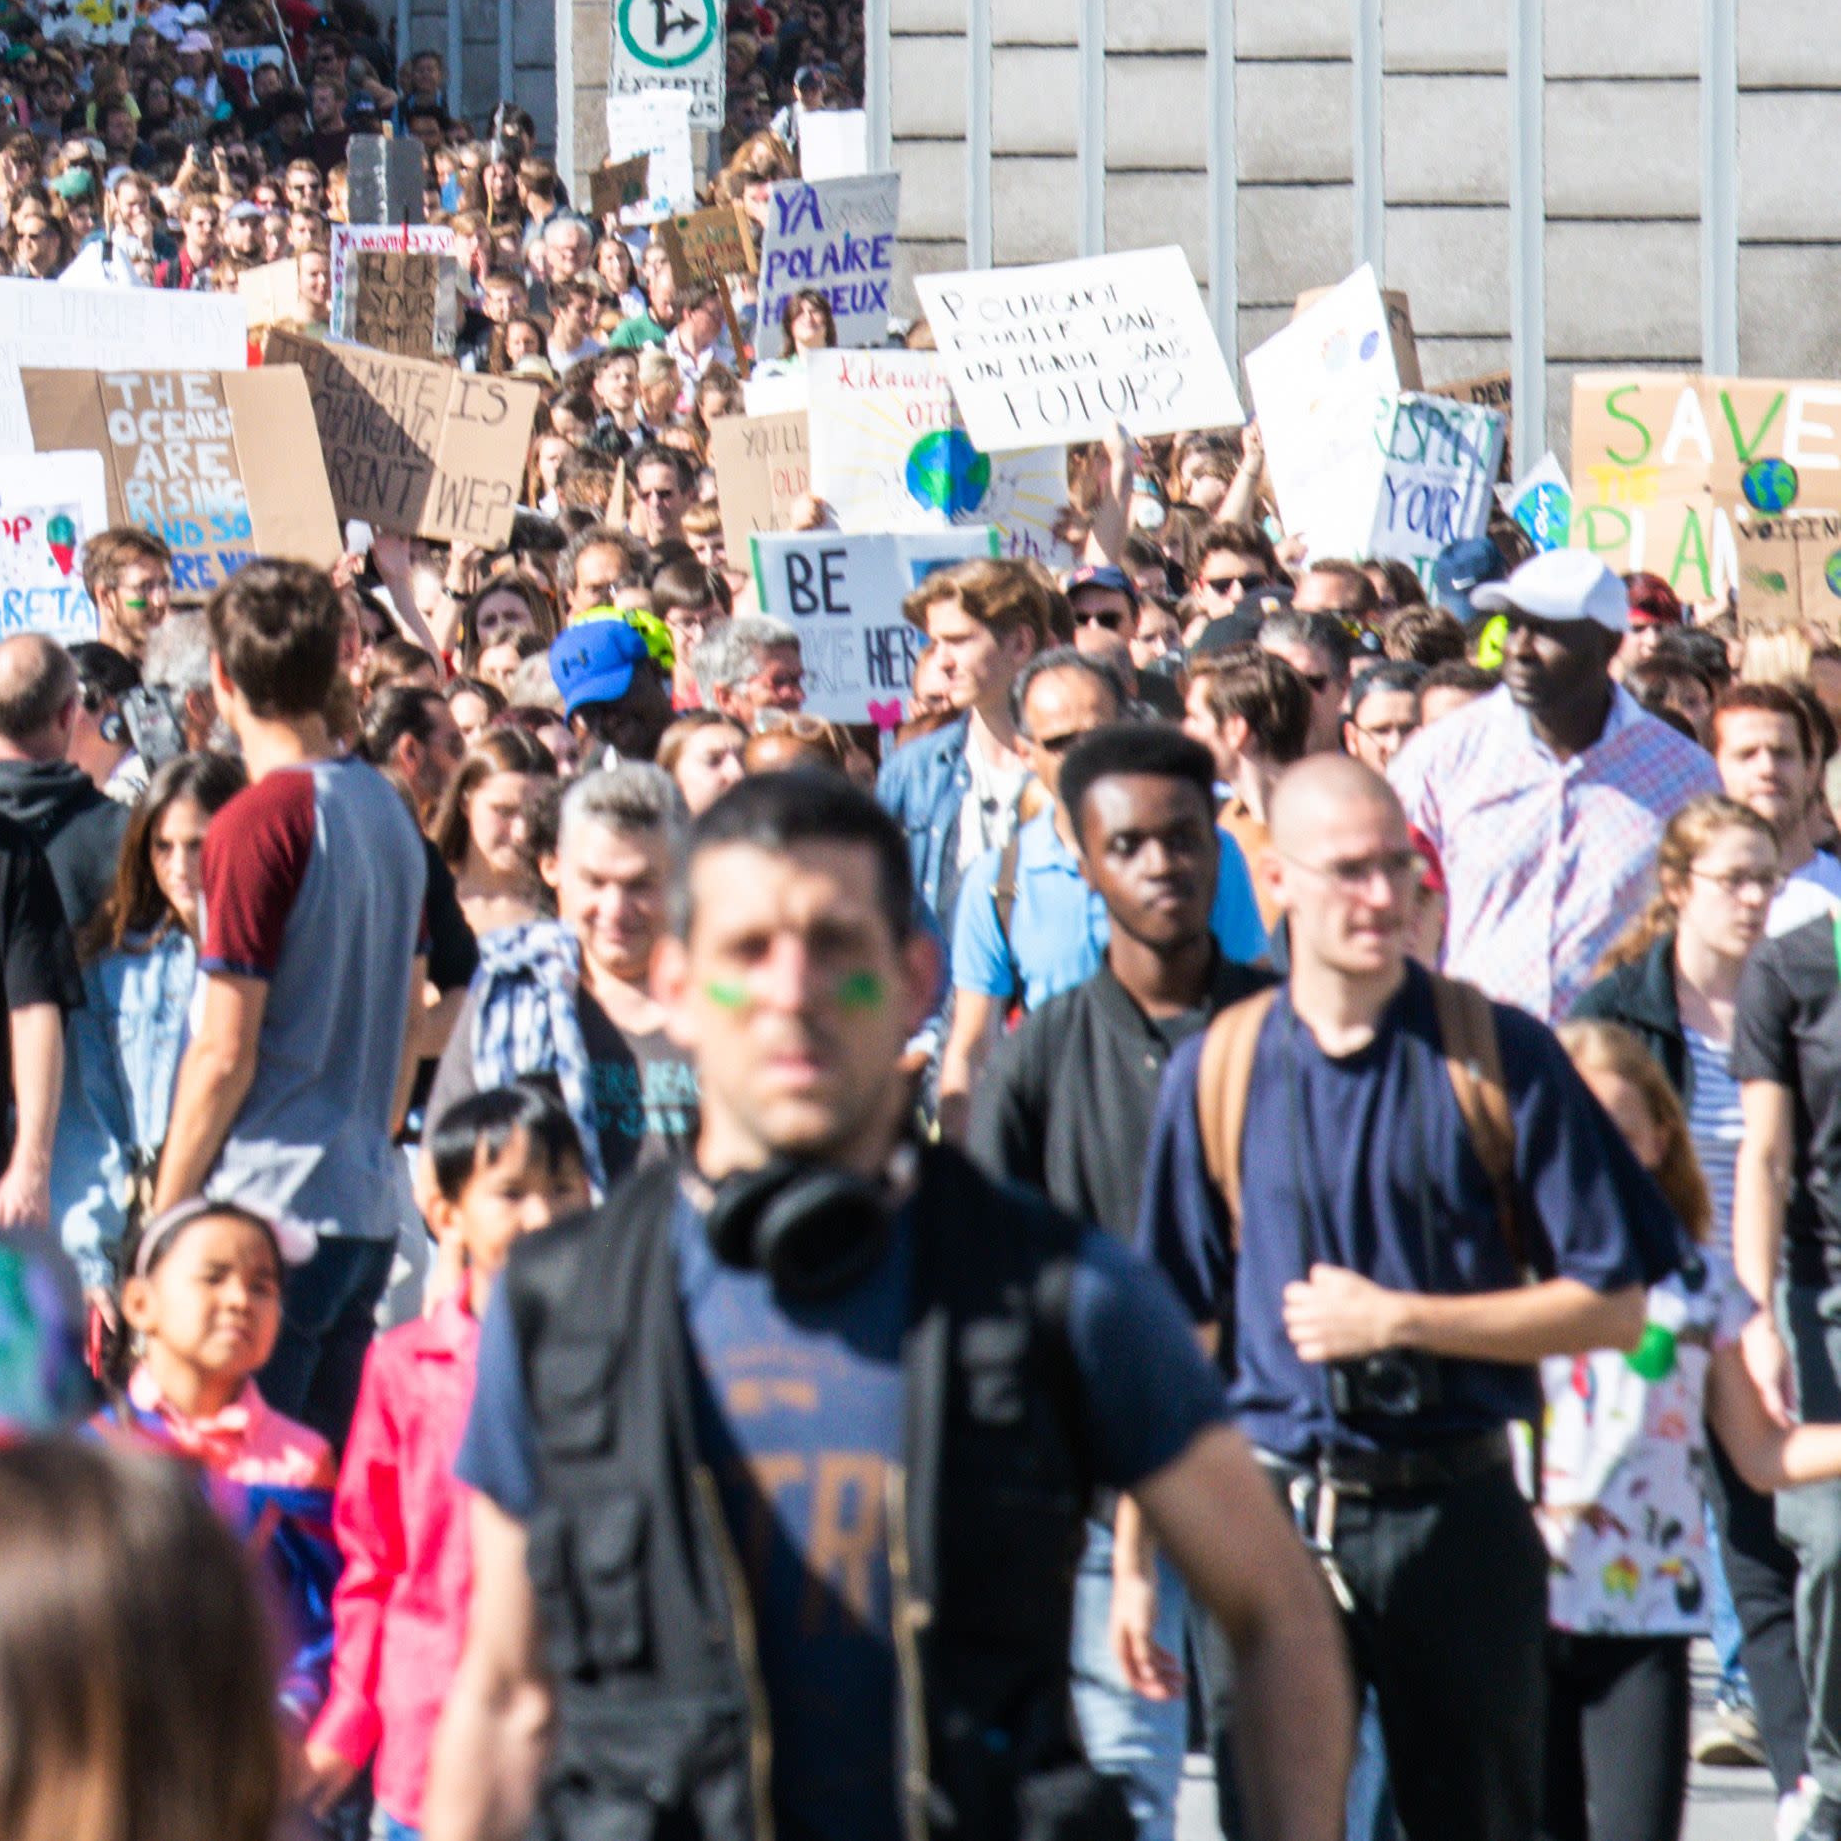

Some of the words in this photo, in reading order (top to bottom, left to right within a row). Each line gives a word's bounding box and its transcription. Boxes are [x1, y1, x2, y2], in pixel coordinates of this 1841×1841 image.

[765, 231, 893, 288] POLAIRE
[104, 372, 218, 412] THE
[447, 376, 510, 427] IS
[1002, 370, 1186, 430] FUTUR?
[107, 407, 232, 447] OCEANS
[1605, 381, 1841, 466] SAVE
[133, 443, 231, 481] ARE
[124, 479, 249, 527] RISING
[210, 515, 253, 545] SO
[436, 463, 514, 545] WE?
[1383, 472, 1461, 543] YOUR
[784, 548, 852, 616] BE
[865, 624, 917, 690] HER
